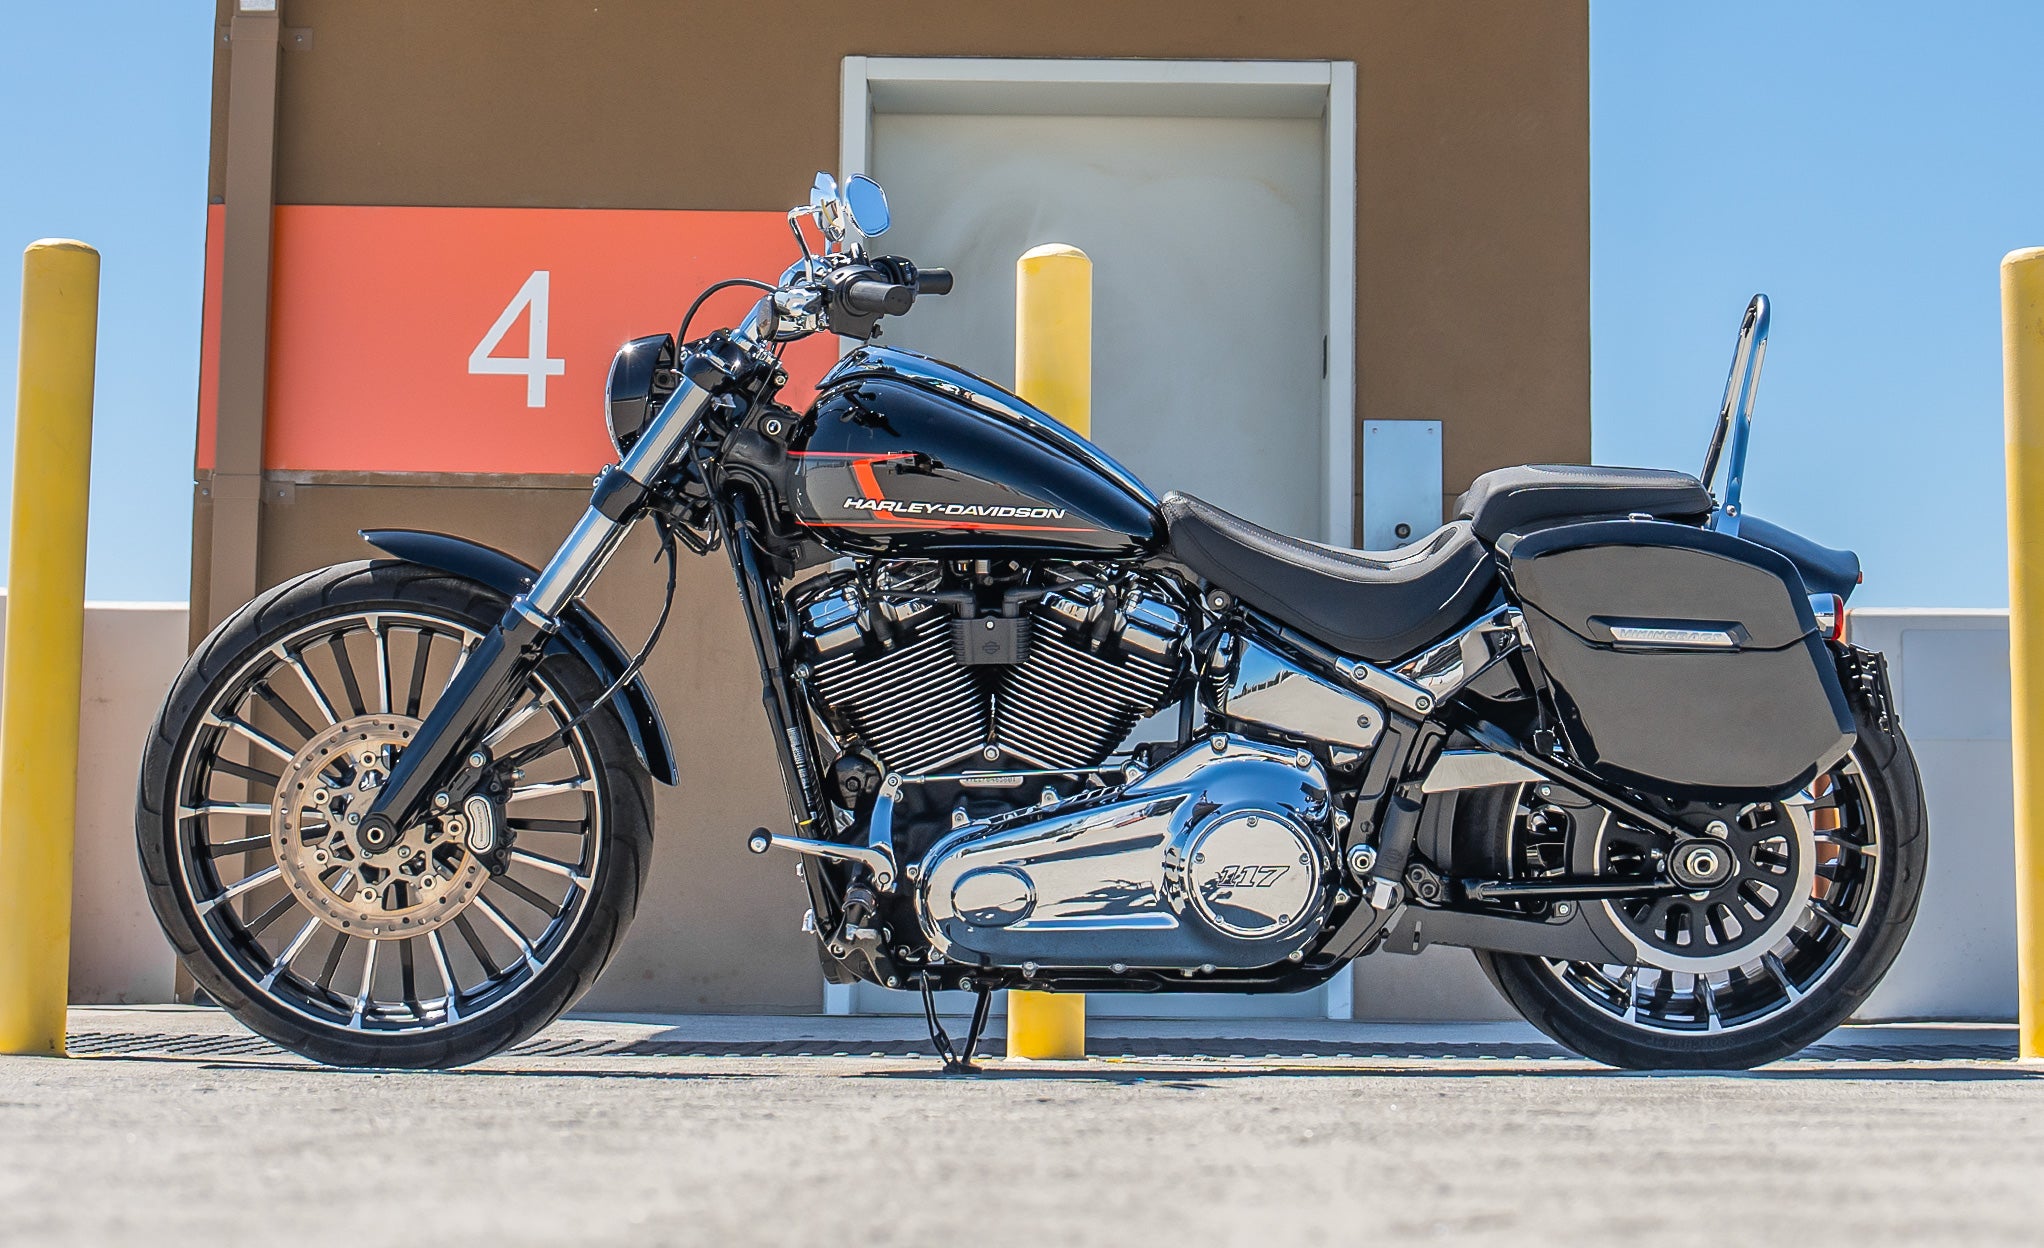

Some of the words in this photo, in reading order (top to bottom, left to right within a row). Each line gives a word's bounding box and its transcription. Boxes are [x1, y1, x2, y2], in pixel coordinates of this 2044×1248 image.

[468, 270, 565, 408] 4
[843, 497, 1066, 519] HARLEY-DAVIDSON
[1217, 865, 1291, 888] 117
